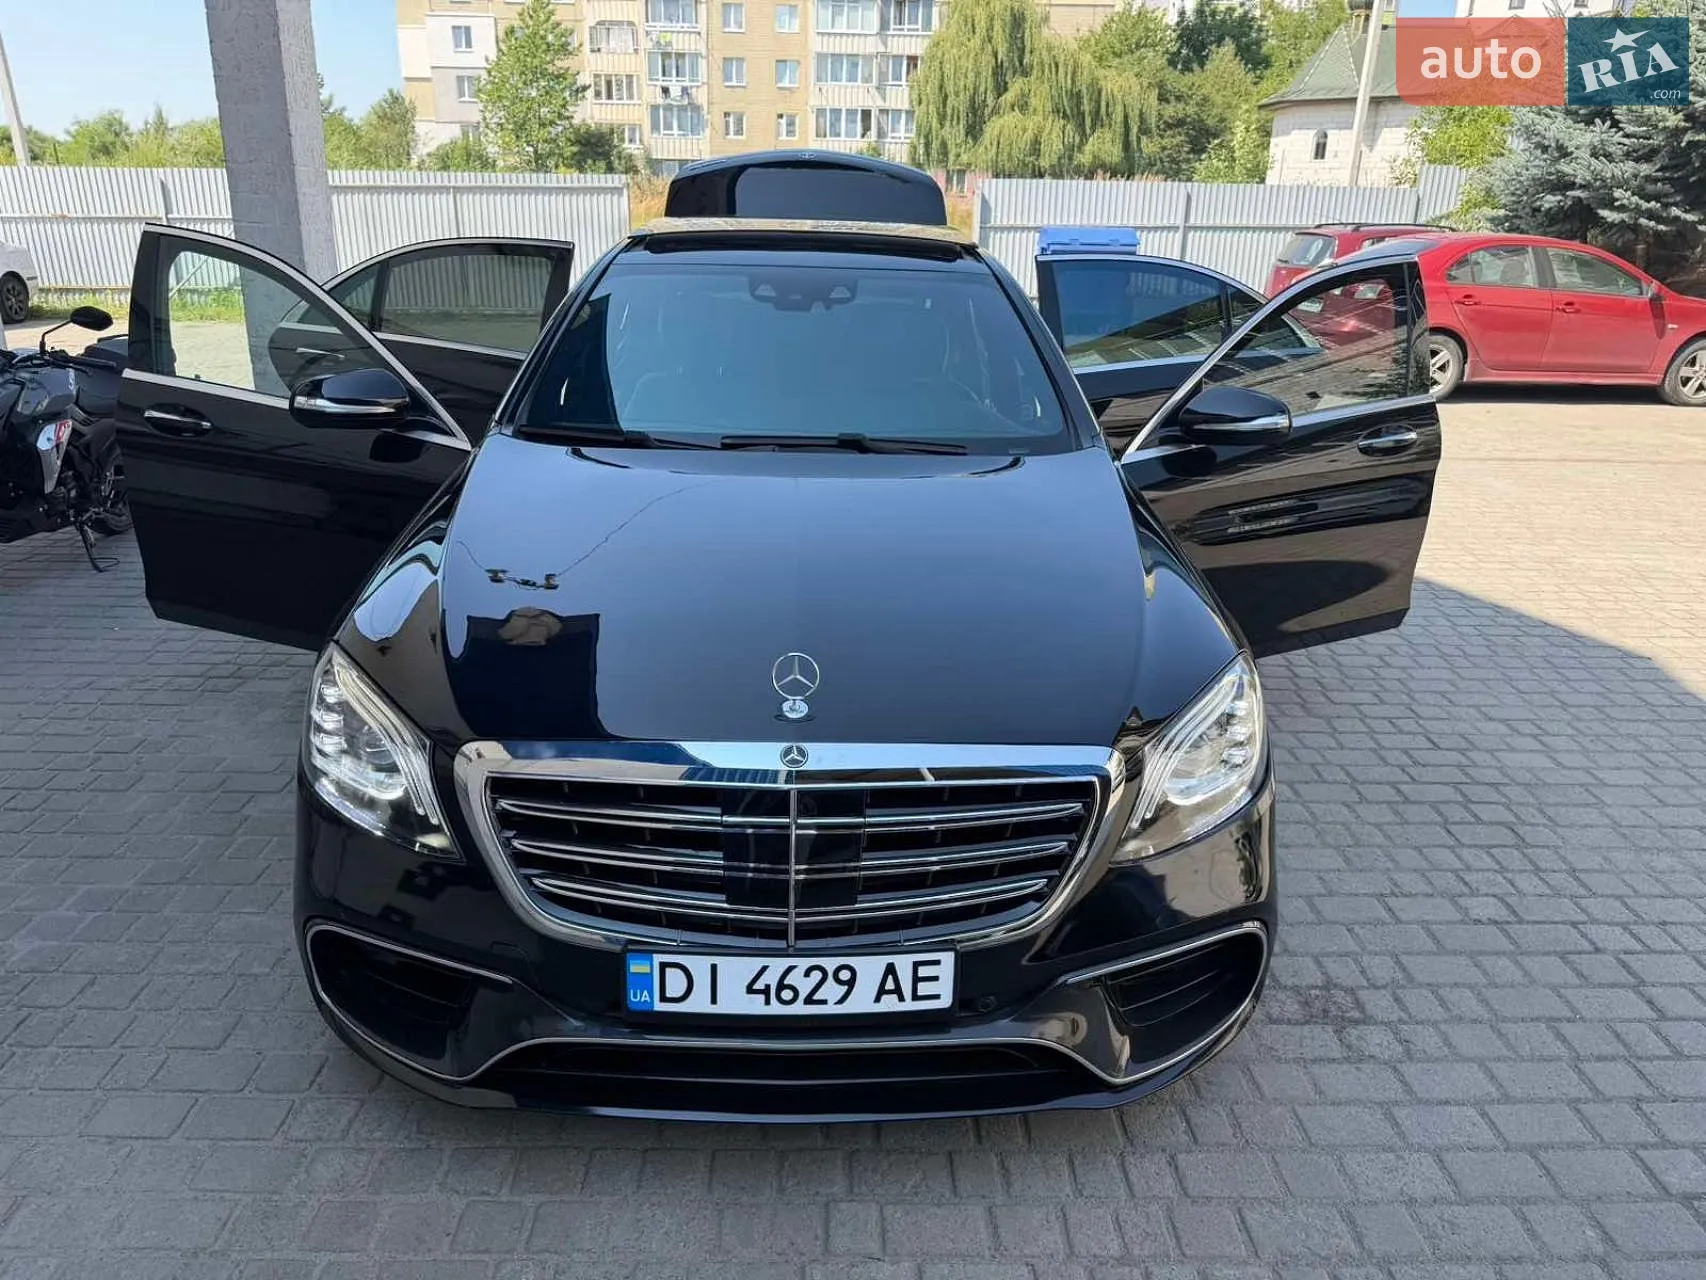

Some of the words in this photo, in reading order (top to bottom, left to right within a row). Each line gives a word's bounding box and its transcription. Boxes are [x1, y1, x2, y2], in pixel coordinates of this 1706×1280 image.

[630, 990, 650, 1003] UA
[658, 961, 718, 1005] DI
[745, 965, 857, 1006] 4629
[873, 959, 942, 1004] AE
